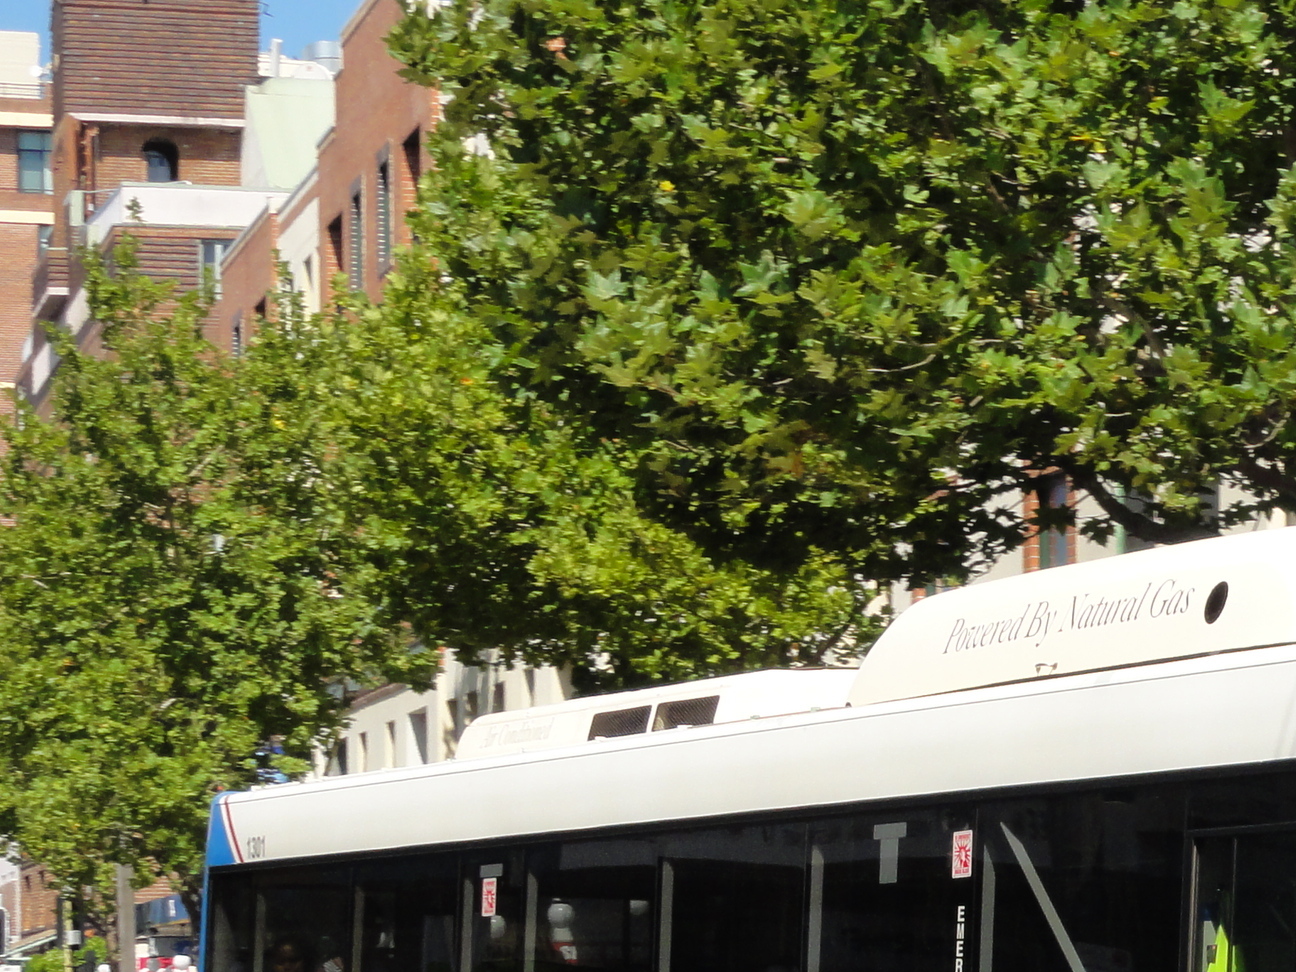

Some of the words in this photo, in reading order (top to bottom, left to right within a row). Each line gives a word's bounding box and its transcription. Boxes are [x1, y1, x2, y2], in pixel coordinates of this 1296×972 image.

[943, 603, 1031, 654] Powered
[1024, 601, 1057, 647] By
[1058, 582, 1152, 632] Natural
[1150, 579, 1195, 618] Gas
[247, 835, 266, 858] 1301
